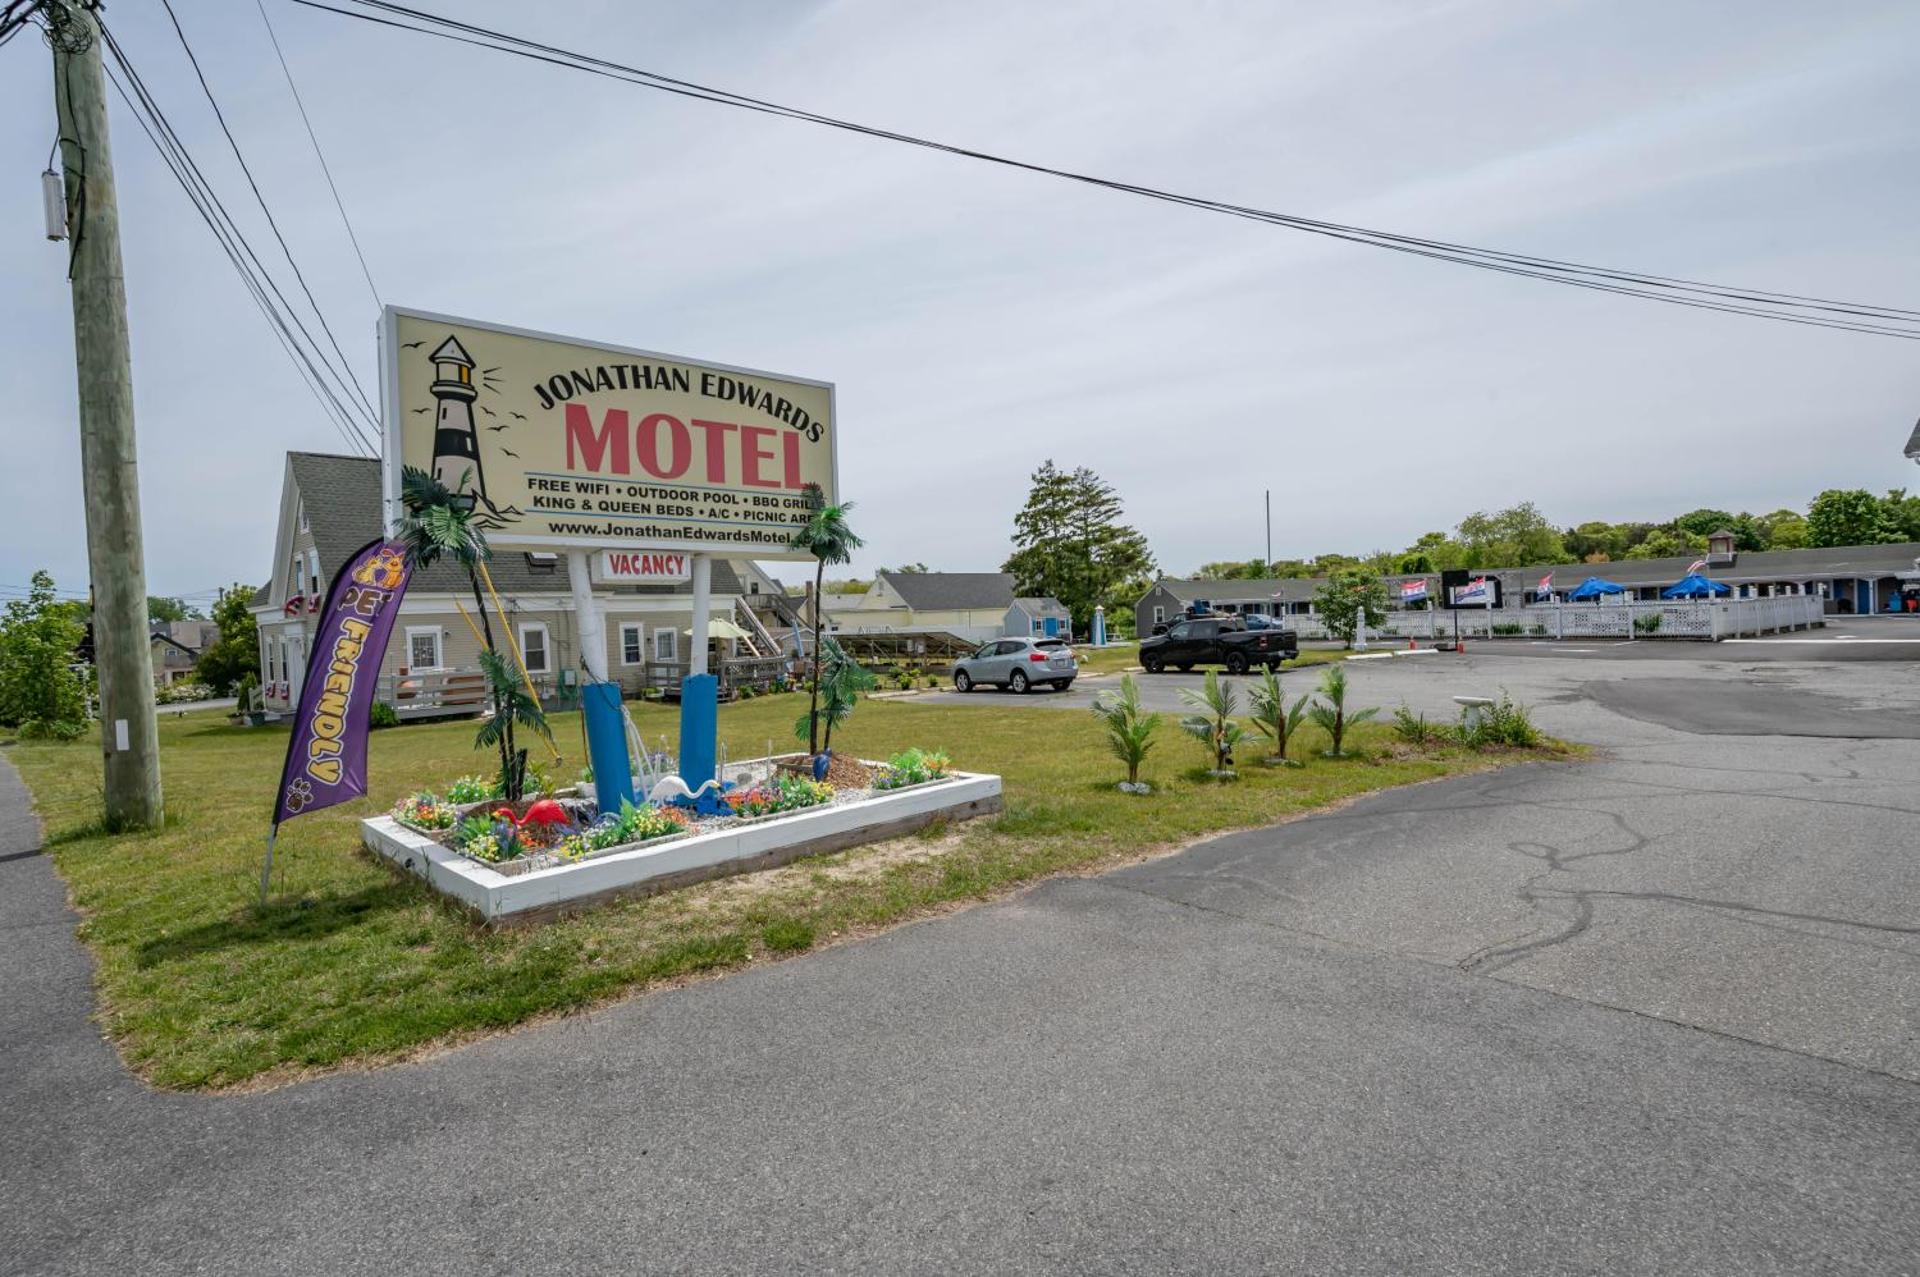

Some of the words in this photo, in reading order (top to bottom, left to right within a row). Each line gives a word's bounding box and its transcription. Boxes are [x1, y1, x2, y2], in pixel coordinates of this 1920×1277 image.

[534, 365, 689, 410] JONATHAN
[701, 372, 824, 443] EDWARDS
[565, 402, 820, 490] MOTEL
[528, 478, 570, 492] FREE
[575, 482, 609, 495] WIFI
[627, 486, 699, 501] OUTDOOR
[703, 493, 739, 505] POOL
[753, 496, 779, 508] BBQ
[533, 495, 575, 509] KING
[581, 499, 592, 511] &
[598, 500, 650, 514] QUEEN
[656, 504, 694, 517] BEDS
[708, 508, 729, 519] A/C
[744, 510, 786, 522] PICNIC
[790, 513, 814, 524] ARE
[609, 554, 684, 575] VACANCY
[307, 617, 372, 785] FRIENDLY
